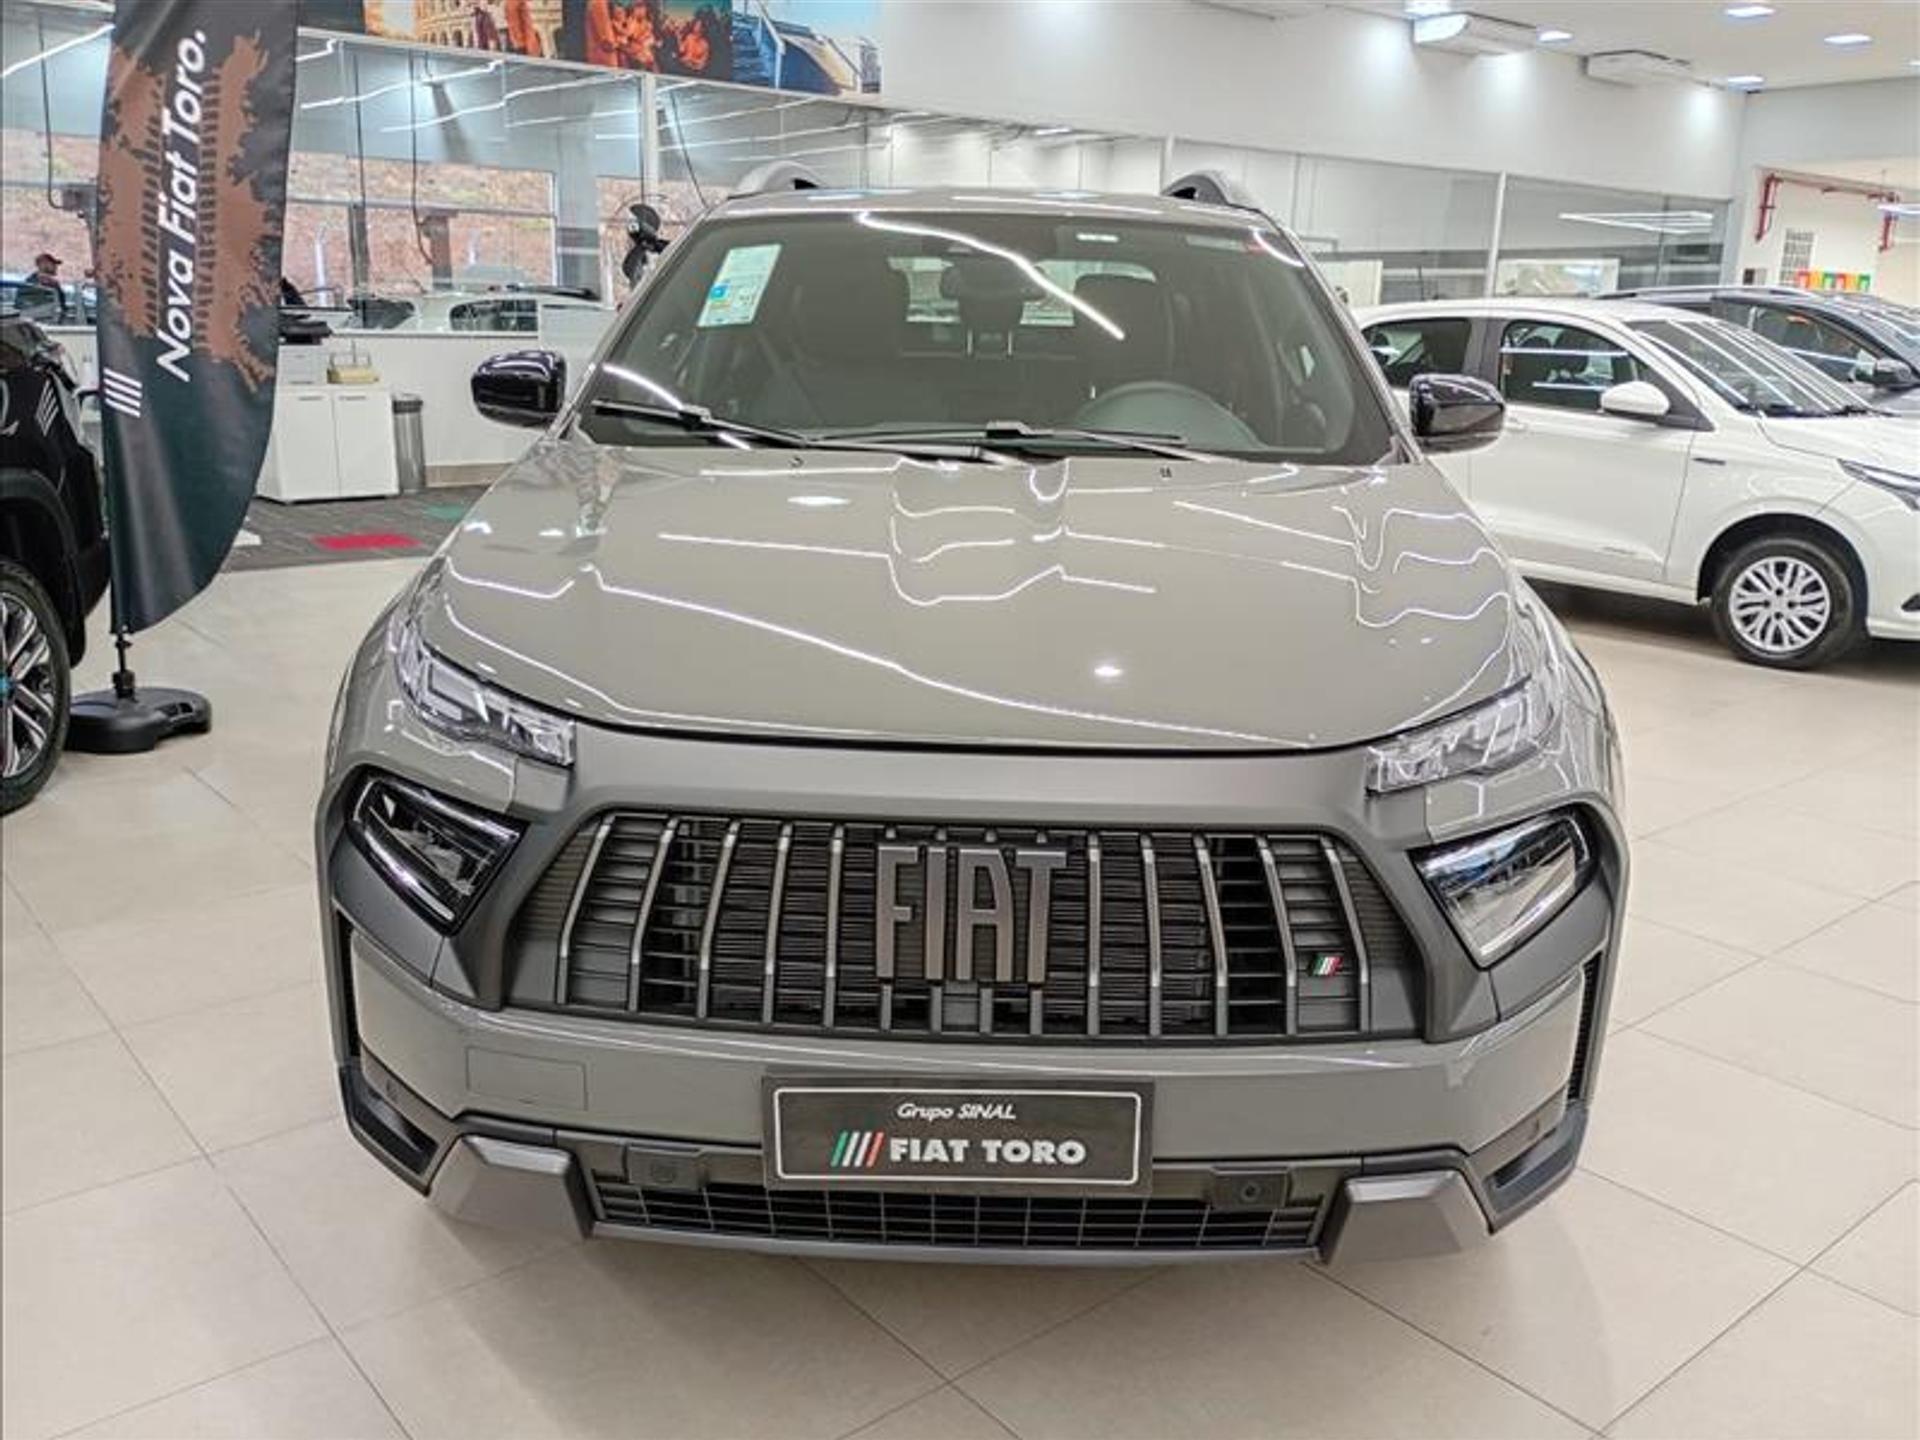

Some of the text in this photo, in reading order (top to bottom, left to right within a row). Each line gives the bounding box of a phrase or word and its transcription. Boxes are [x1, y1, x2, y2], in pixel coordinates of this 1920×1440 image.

[156, 30, 206, 382] Nova Fiat Toro.
[876, 846, 1066, 983] FIAT
[889, 1138, 1087, 1165] FIAT TORO
[897, 1103, 1016, 1121] Grupo SINAL
